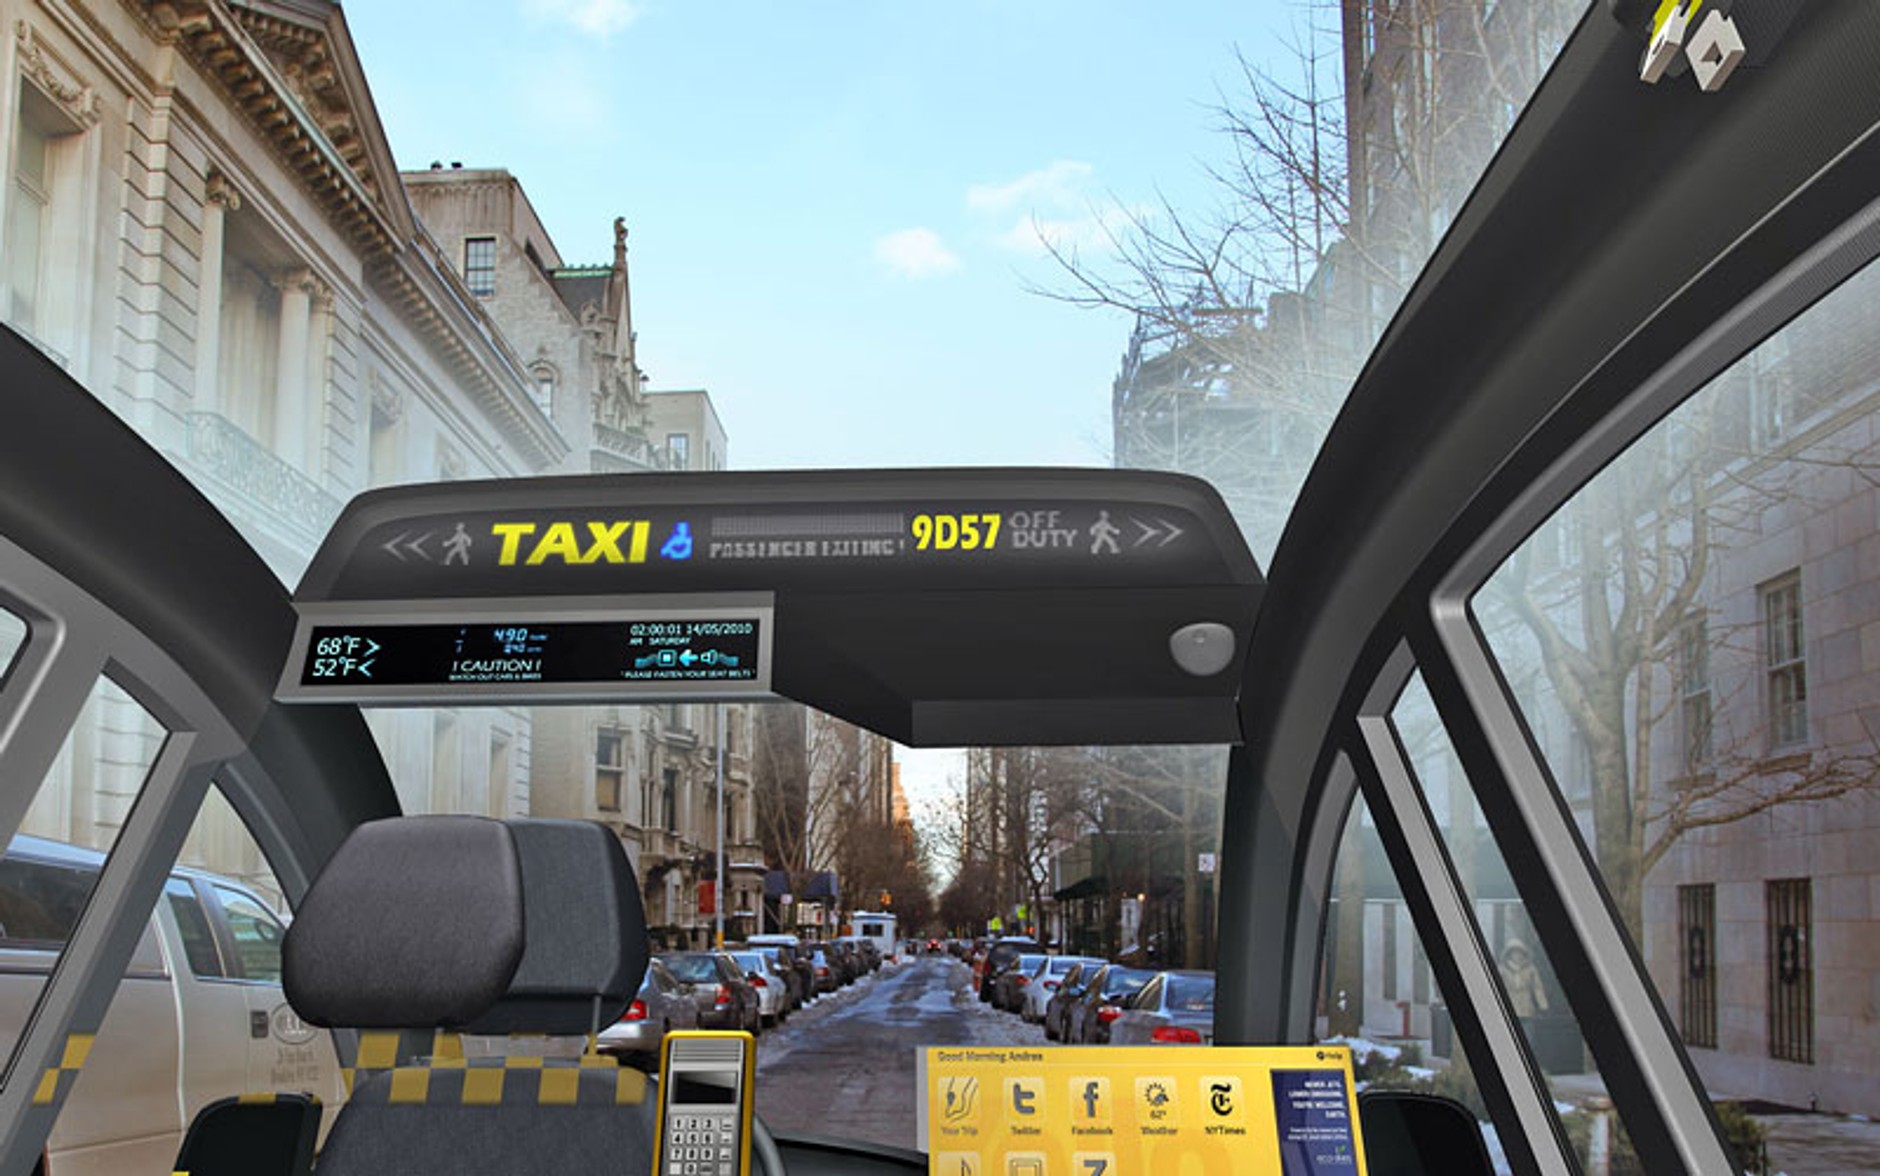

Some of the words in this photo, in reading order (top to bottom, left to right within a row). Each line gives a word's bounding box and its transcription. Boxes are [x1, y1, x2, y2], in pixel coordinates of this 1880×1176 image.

[1009, 510, 1061, 529] OFF
[911, 514, 1002, 550] 9D57
[1012, 528, 1078, 549] DUTY
[491, 520, 651, 566] TAXI
[317, 635, 361, 655] 68°F
[312, 656, 358, 677] 52°F
[460, 660, 533, 672] CAUTION
[938, 1051, 963, 1062] Good
[966, 1051, 1006, 1064] Morning
[1011, 1126, 1042, 1135] Twitter
[1072, 1126, 1113, 1135] Facebook
[1140, 1126, 1178, 1135] Weather
